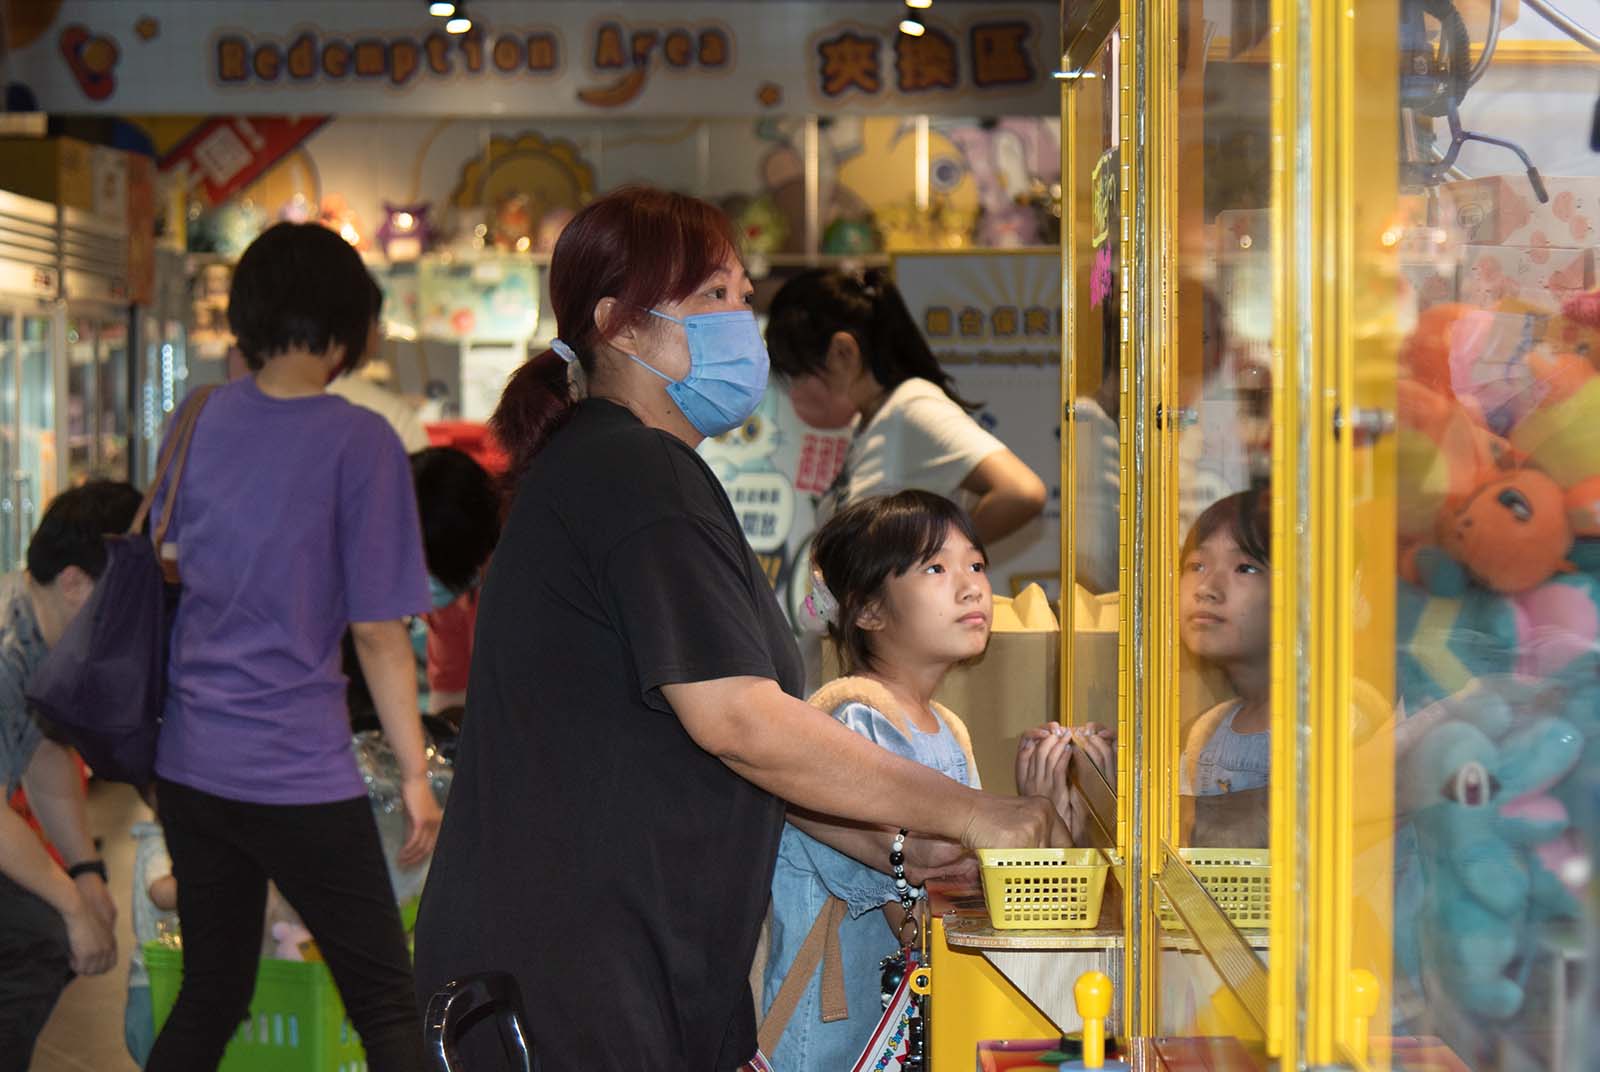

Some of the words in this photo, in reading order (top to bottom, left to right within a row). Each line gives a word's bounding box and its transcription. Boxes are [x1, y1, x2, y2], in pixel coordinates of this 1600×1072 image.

[218, 31, 557, 84] Redemption
[595, 22, 728, 68] Area
[874, 1048, 894, 1072] YON
